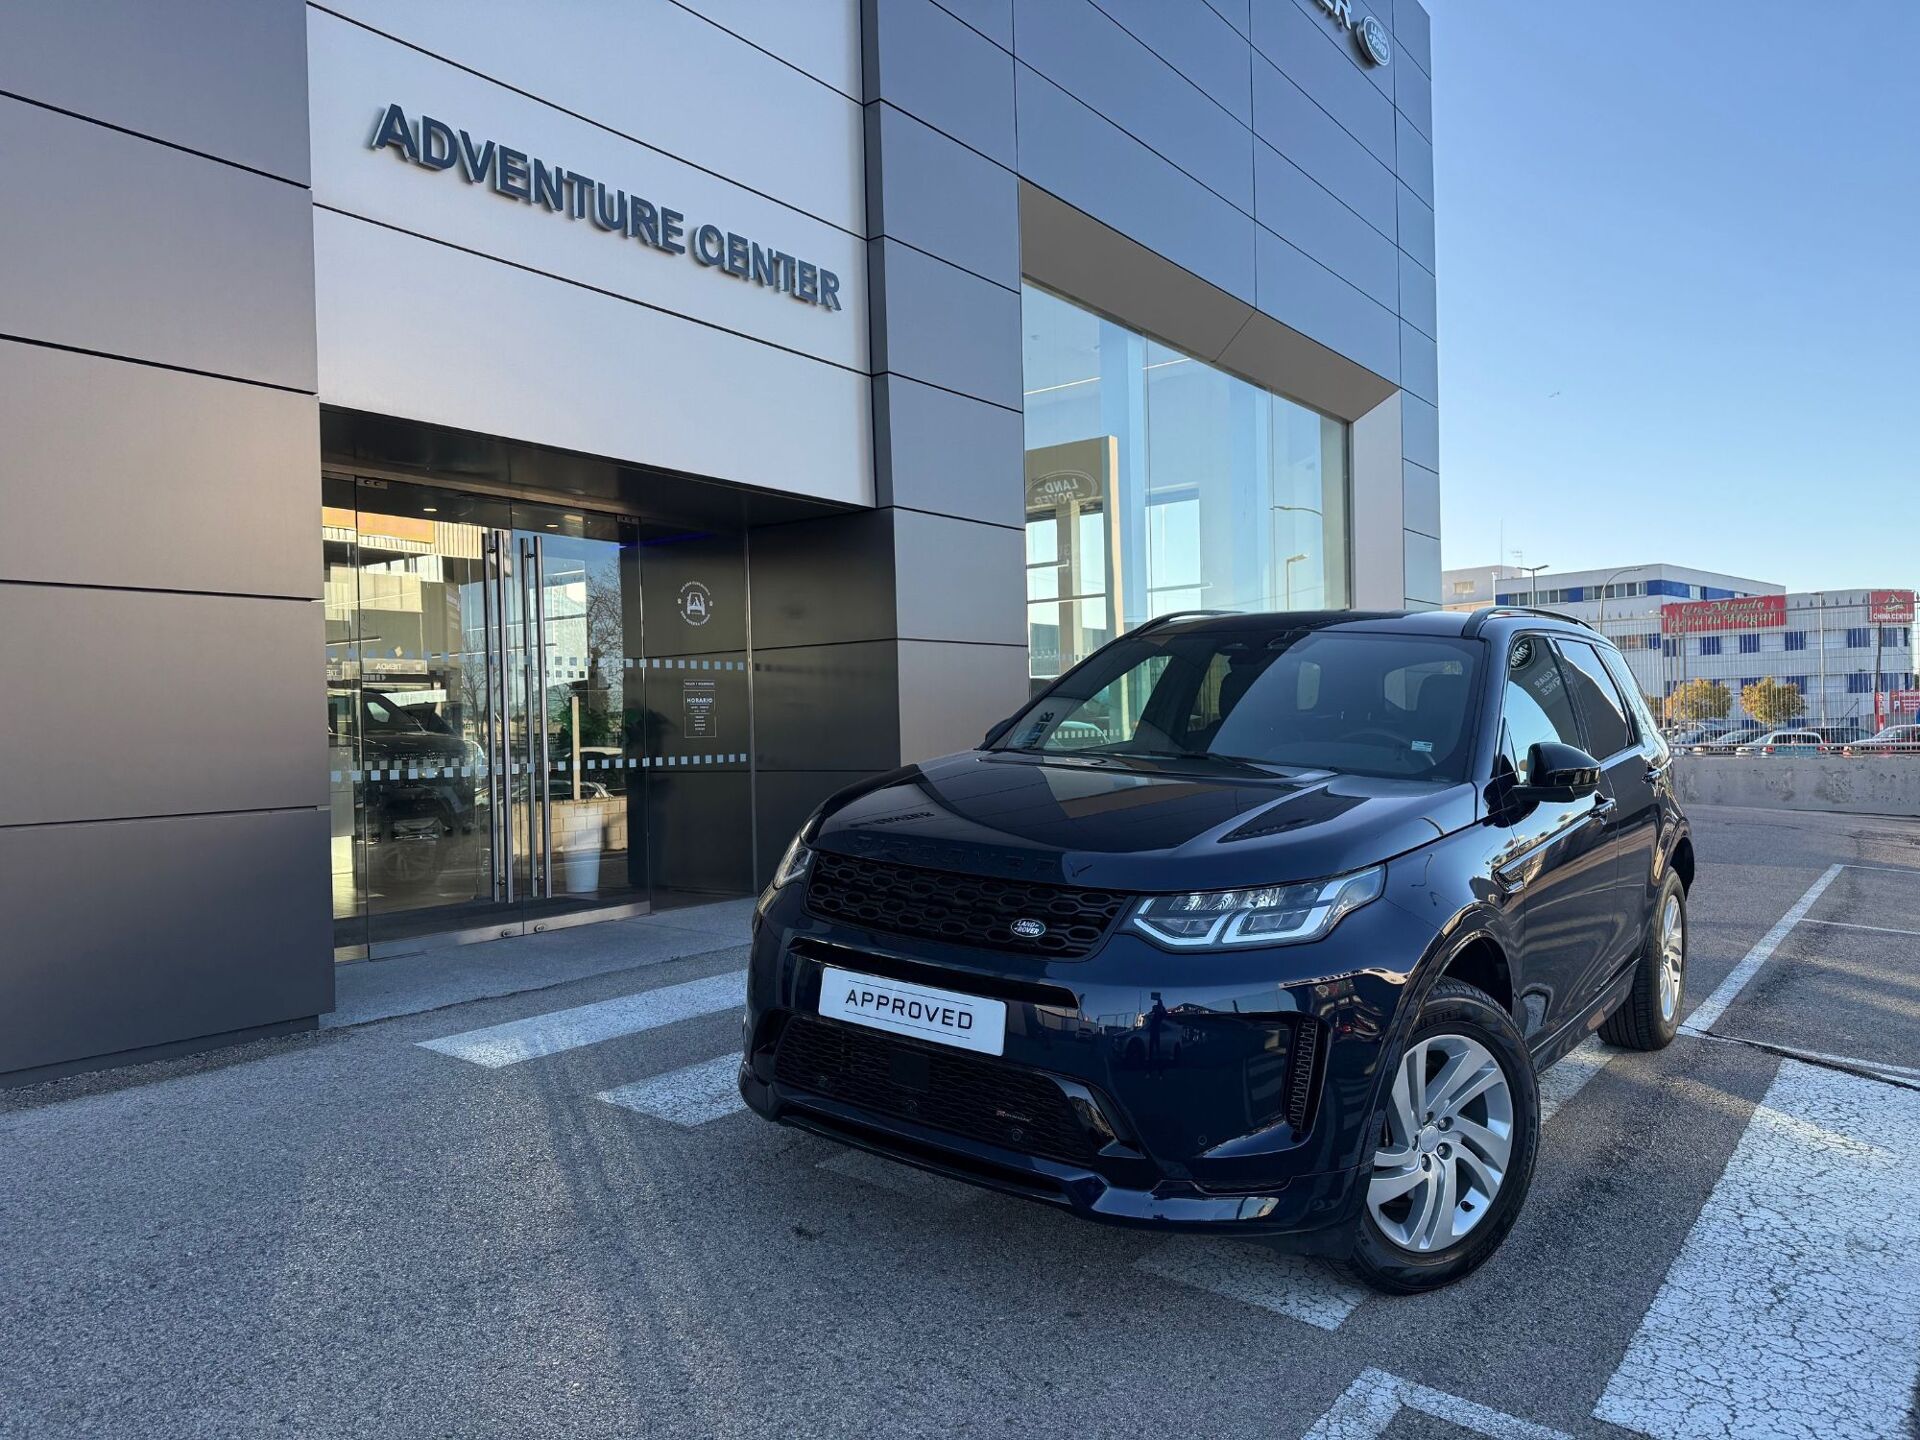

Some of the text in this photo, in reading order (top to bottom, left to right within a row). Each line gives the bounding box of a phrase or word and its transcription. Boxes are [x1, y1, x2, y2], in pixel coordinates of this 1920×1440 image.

[372, 103, 842, 311] ADVENTURE CENTER
[1017, 920, 1036, 928] LAND
[1017, 927, 1040, 935] ROVER
[845, 988, 973, 1031] APPROVED
